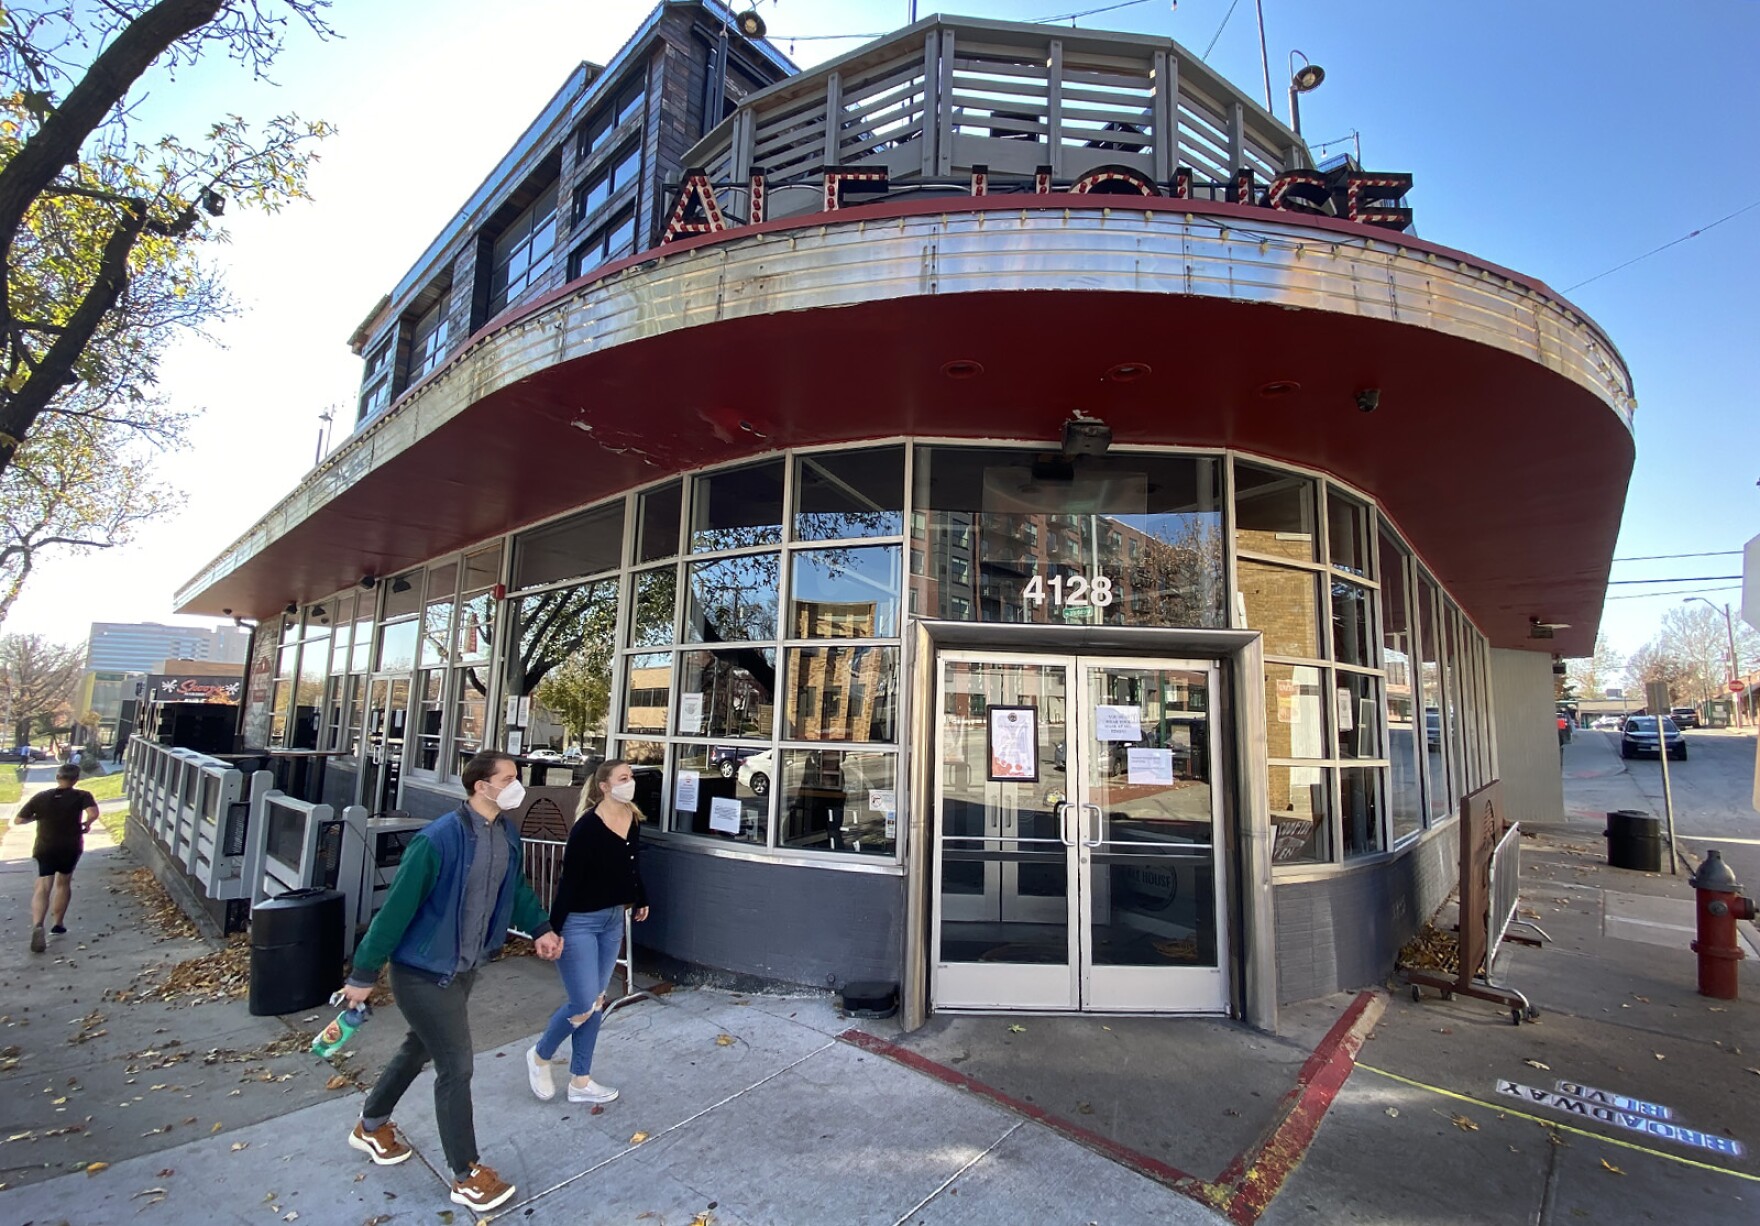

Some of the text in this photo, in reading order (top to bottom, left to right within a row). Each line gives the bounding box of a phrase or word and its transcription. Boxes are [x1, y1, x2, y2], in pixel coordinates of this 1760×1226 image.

[1022, 574, 1113, 607] 4128
[1142, 871, 1171, 888] HOUSE
[1560, 1081, 1669, 1118] BLVD
[1501, 1081, 1740, 1155] BROADWAY
